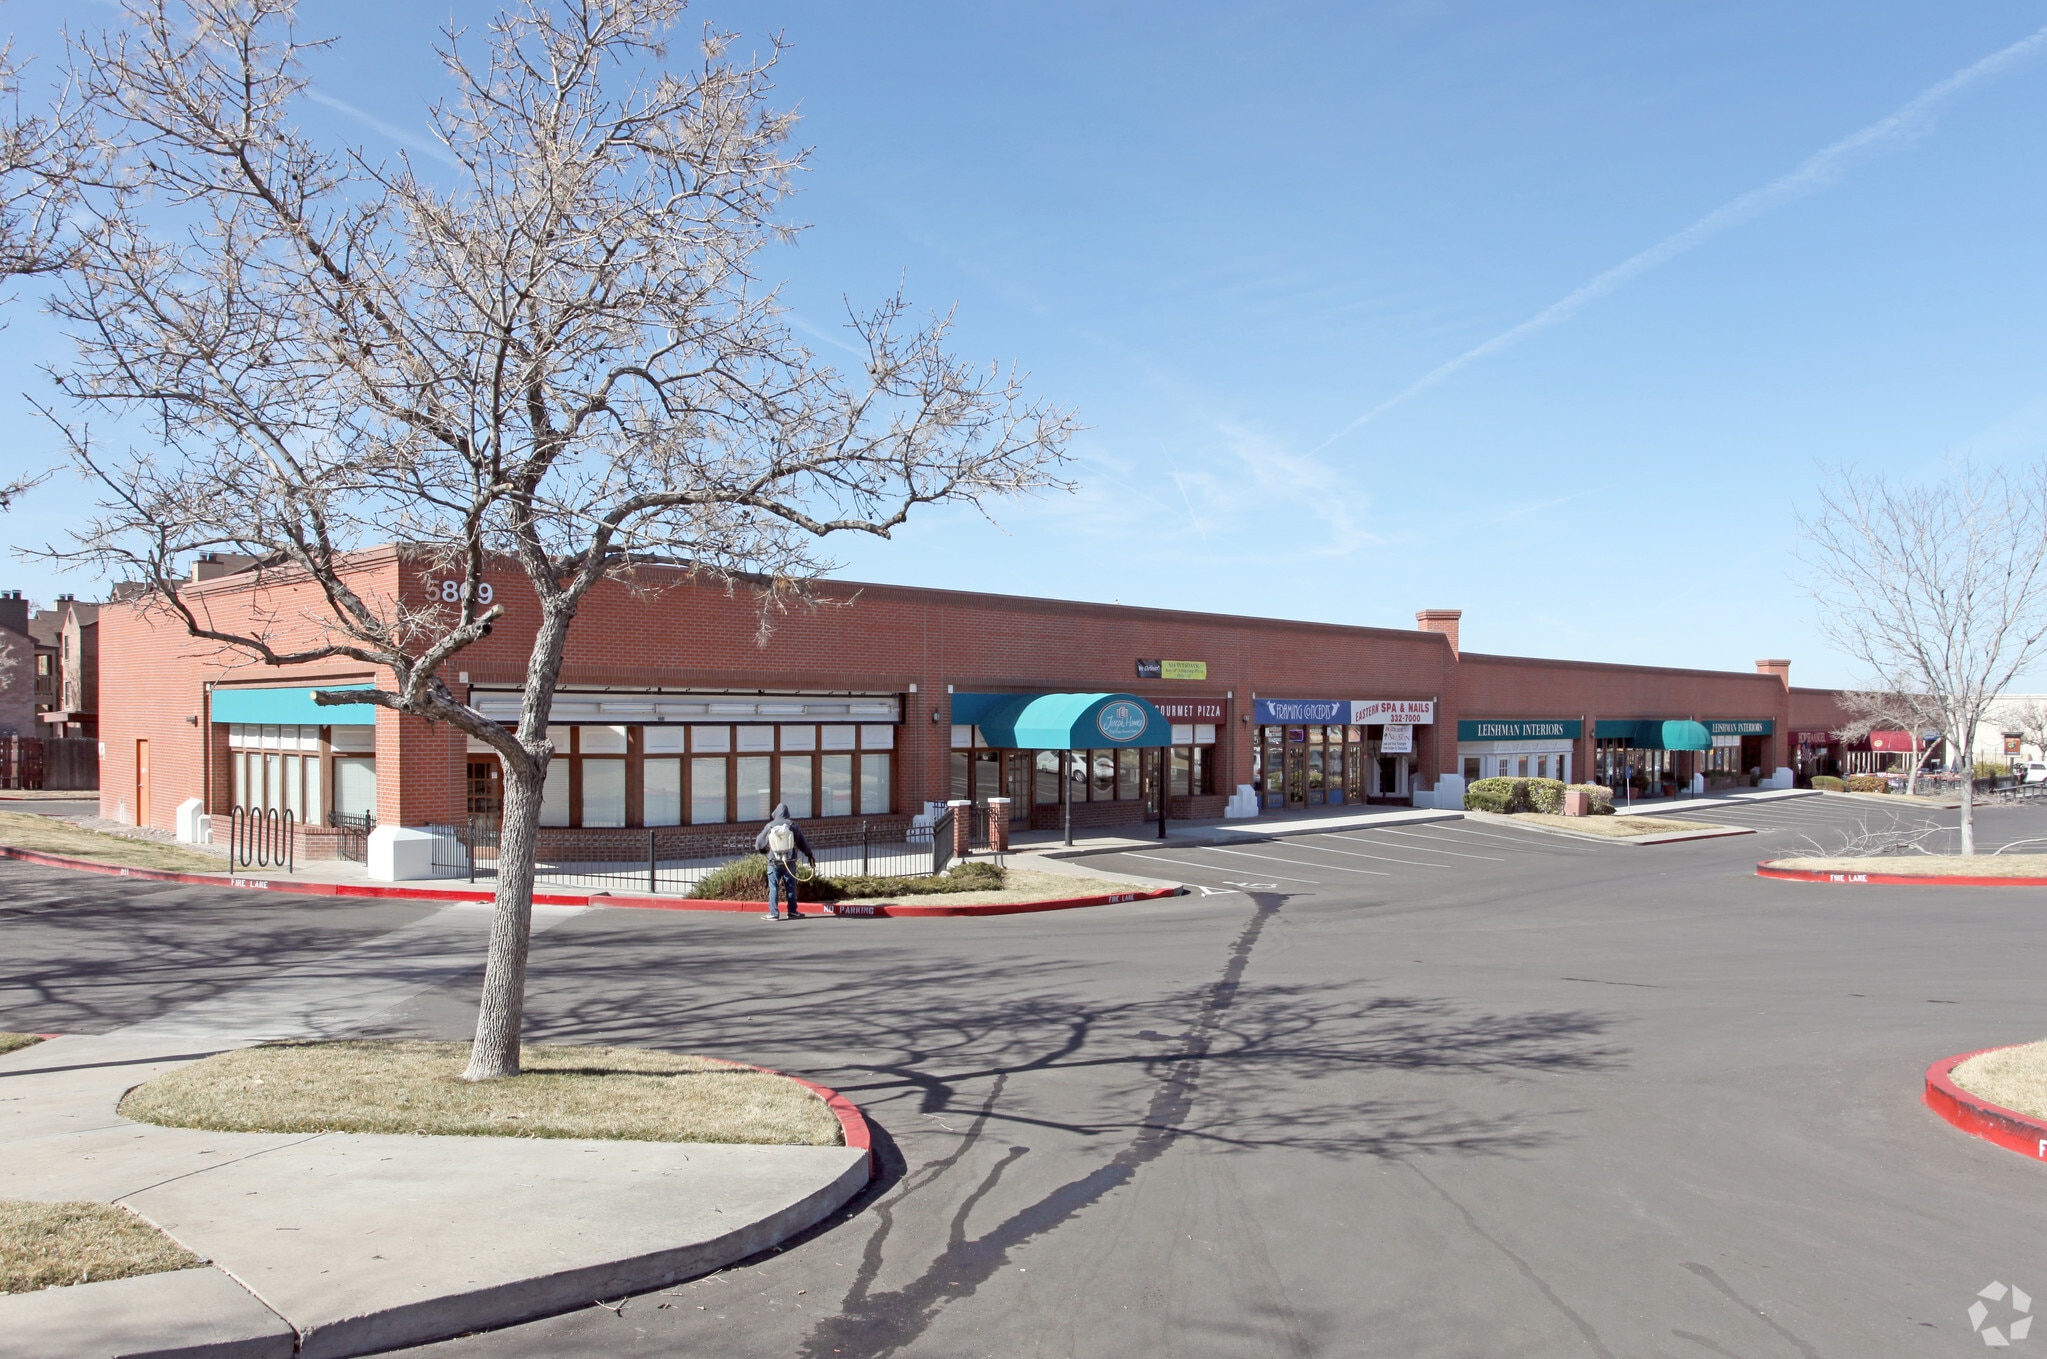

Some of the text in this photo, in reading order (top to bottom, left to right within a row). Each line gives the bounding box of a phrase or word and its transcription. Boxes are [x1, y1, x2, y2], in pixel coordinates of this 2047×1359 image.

[1197, 705, 1221, 717] PIZZA
[1276, 703, 1302, 720] FRAMING
[1355, 702, 1430, 722] EASTERN SPA & NAILS
[1390, 714, 1421, 723] 332-7000
[1477, 723, 1564, 737] LEISHMAN INTERIORS
[1738, 722, 1763, 732] INTERIORS
[1830, 874, 1868, 882] FIRE LANE
[231, 879, 269, 889] FIRE LANE
[823, 905, 875, 915] NO PARKING
